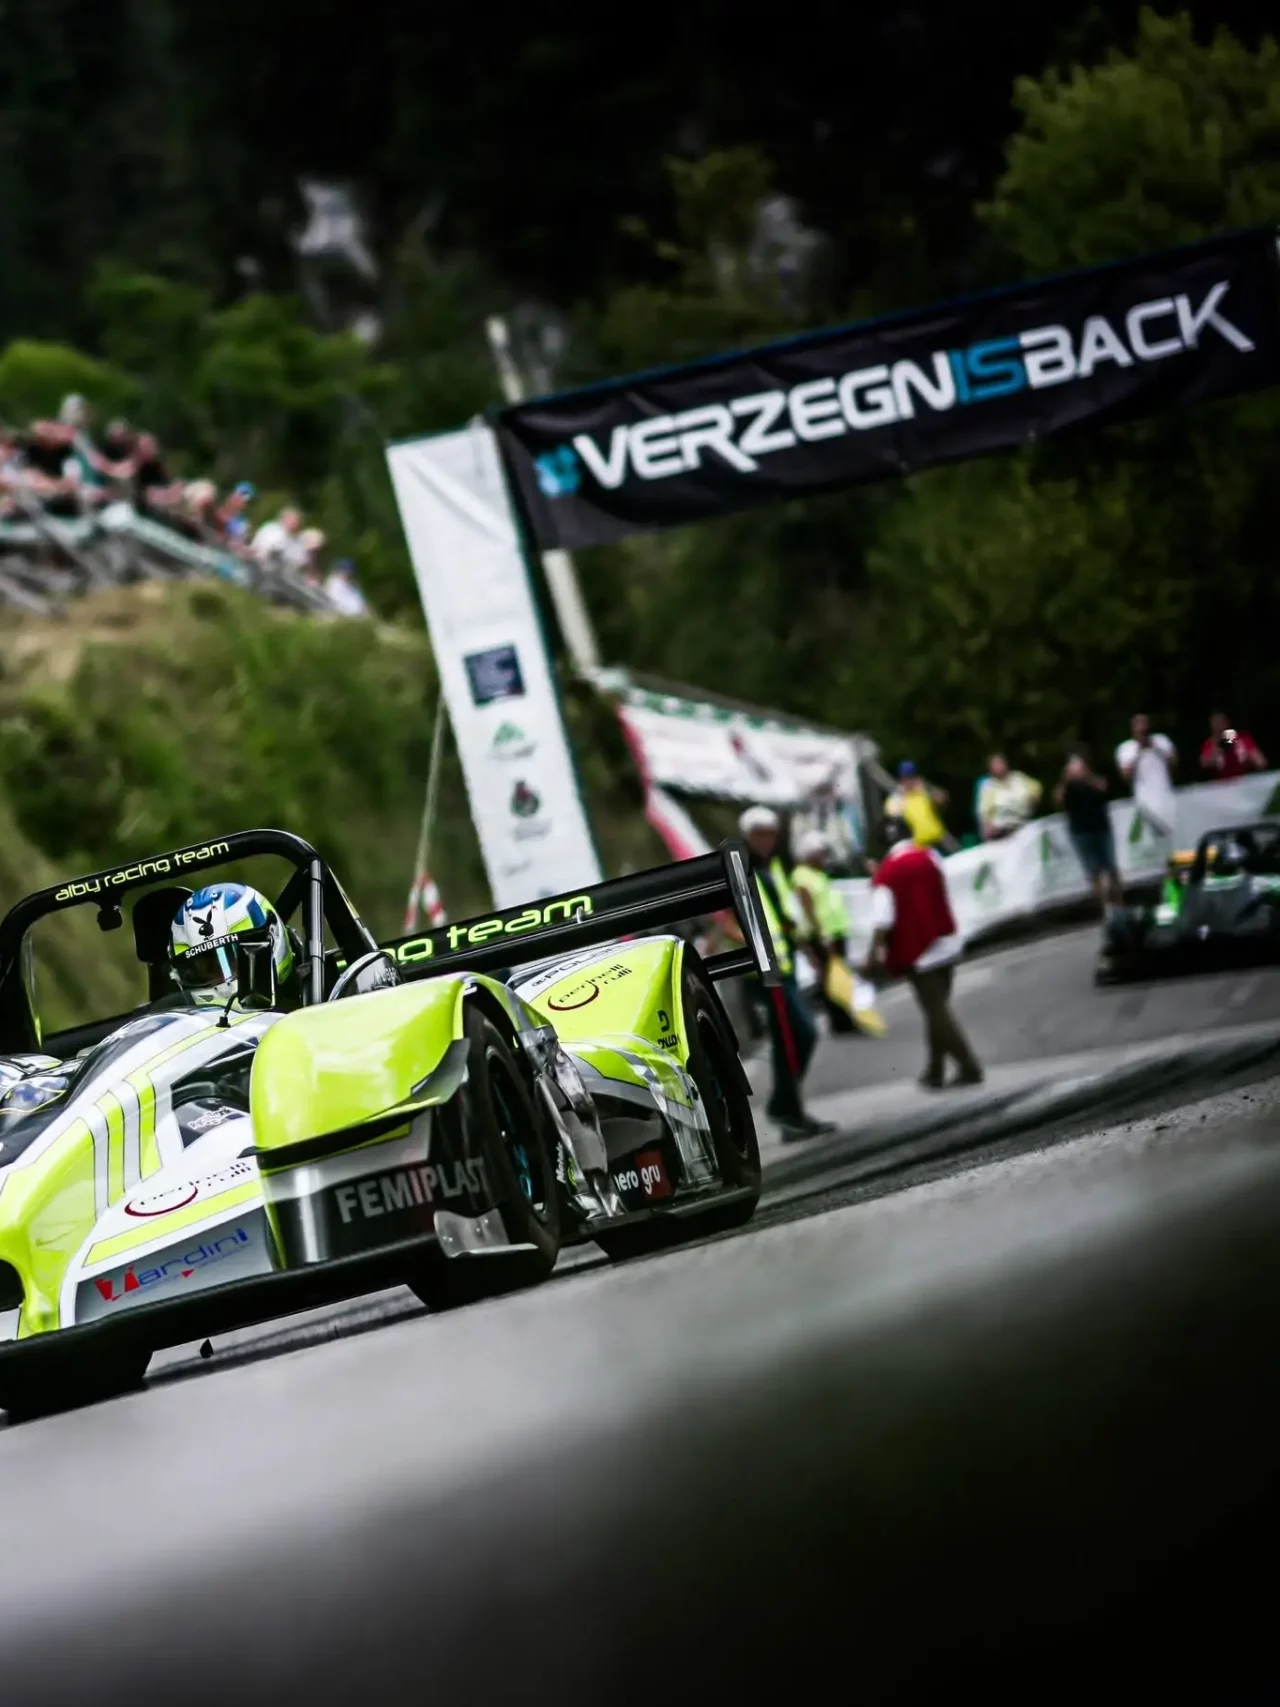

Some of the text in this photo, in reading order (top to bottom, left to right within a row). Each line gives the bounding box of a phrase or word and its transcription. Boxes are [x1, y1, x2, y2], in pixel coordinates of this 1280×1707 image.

[55, 841, 229, 901] alby racing team
[185, 933, 239, 958] SCHUBERTH
[446, 895, 594, 951] team
[334, 1157, 492, 1224] FEMIPLAST
